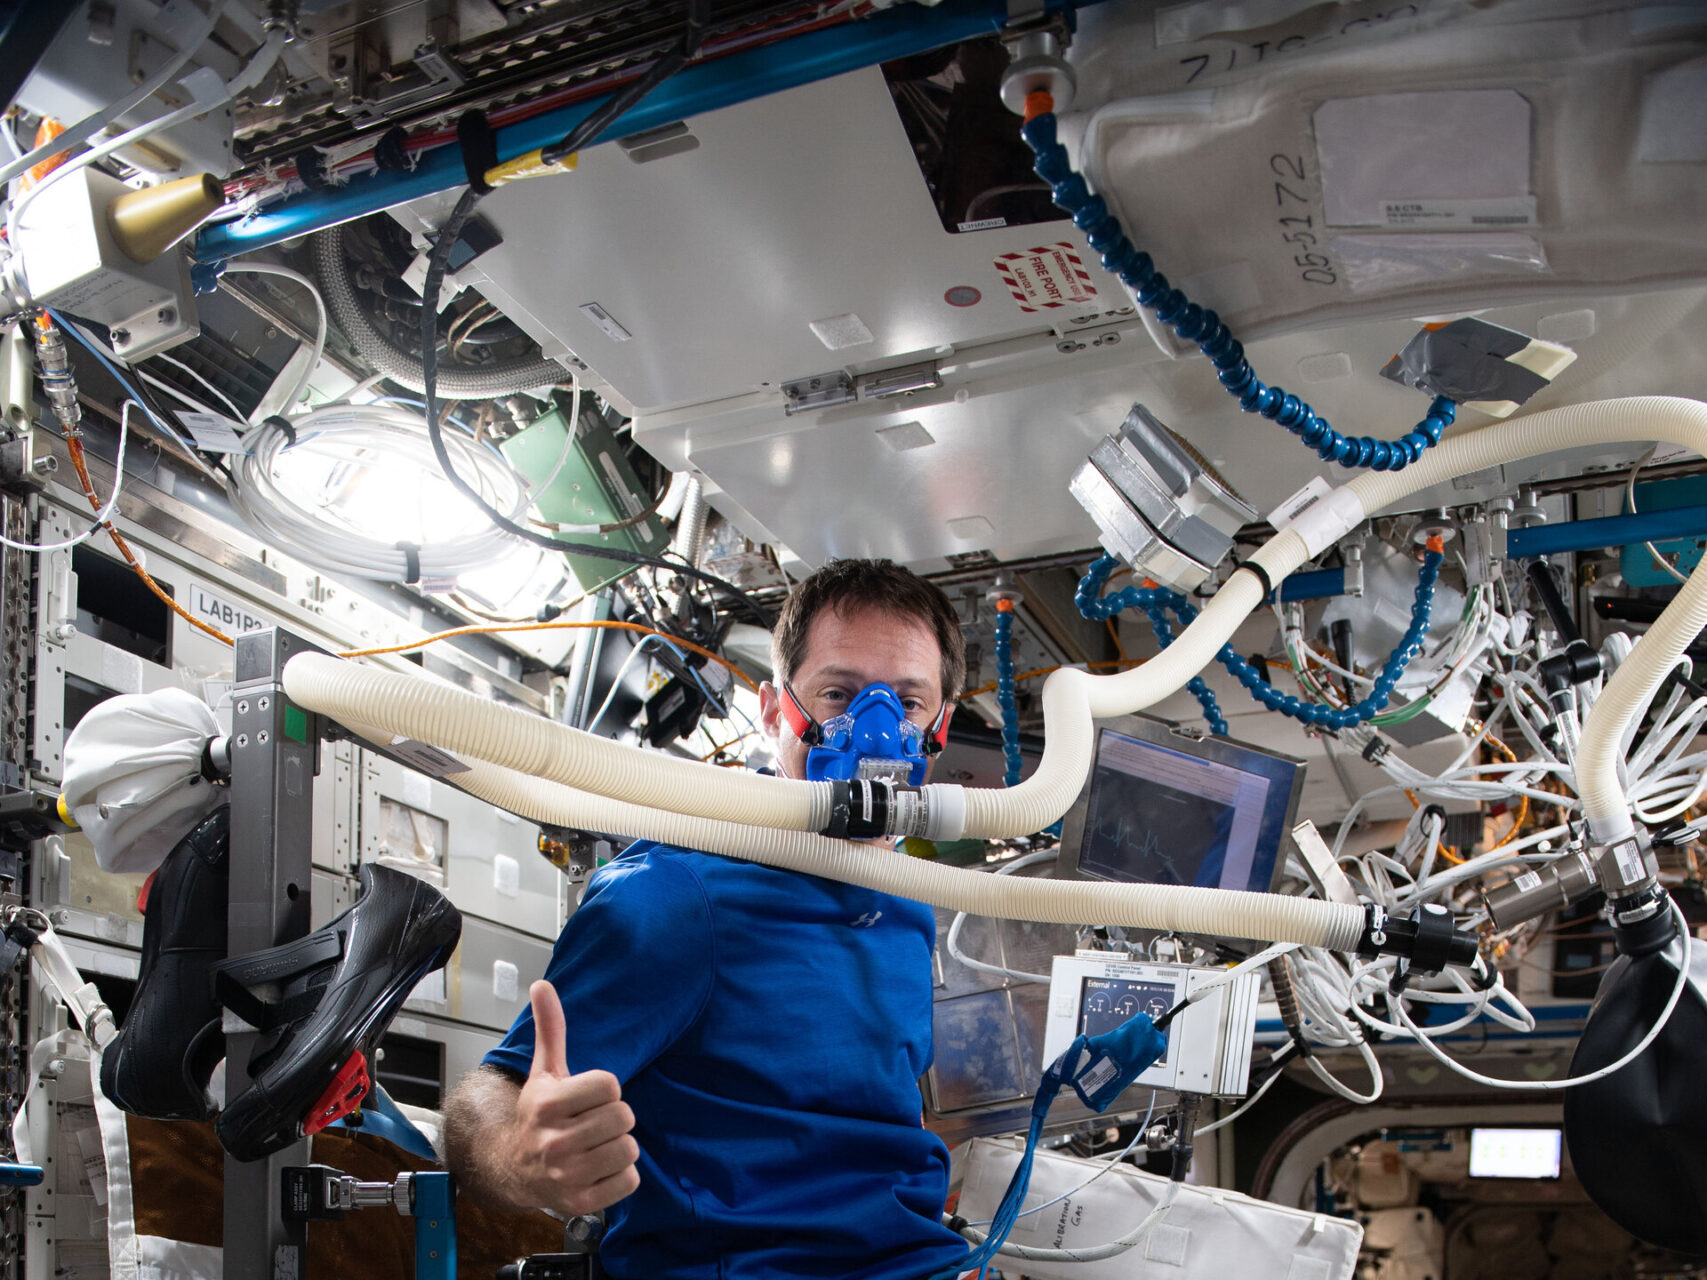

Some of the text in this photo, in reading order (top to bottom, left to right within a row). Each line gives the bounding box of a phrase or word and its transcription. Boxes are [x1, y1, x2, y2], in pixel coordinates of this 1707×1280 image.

[1029, 255, 1063, 300] FIRE PORT
[1051, 250, 1076, 286] EMERGENCY
[1087, 980, 1111, 989] External
[1053, 1196, 1071, 1250] ALIBRATION
